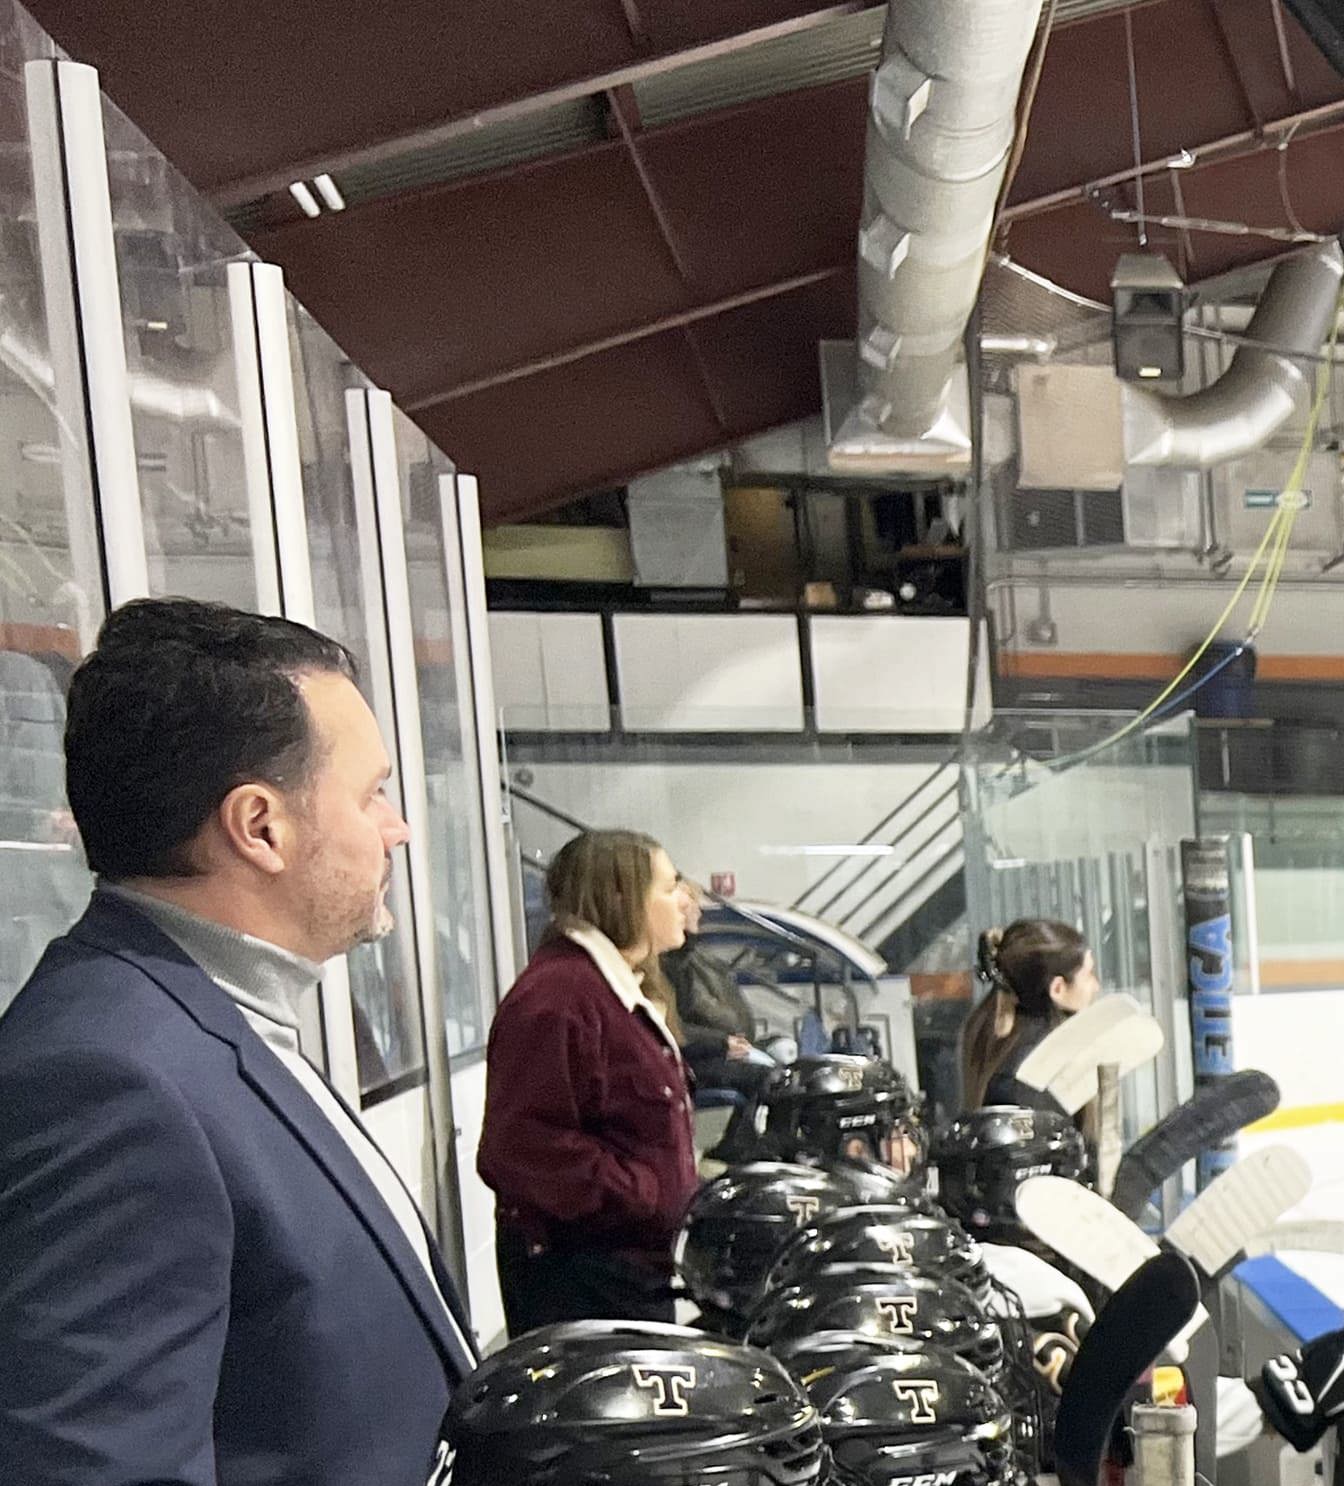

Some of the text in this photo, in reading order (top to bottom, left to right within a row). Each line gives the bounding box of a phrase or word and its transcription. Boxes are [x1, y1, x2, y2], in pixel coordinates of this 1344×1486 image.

[876, 1296, 917, 1332] T
[632, 1365, 696, 1416] T
[893, 1380, 938, 1420] T
